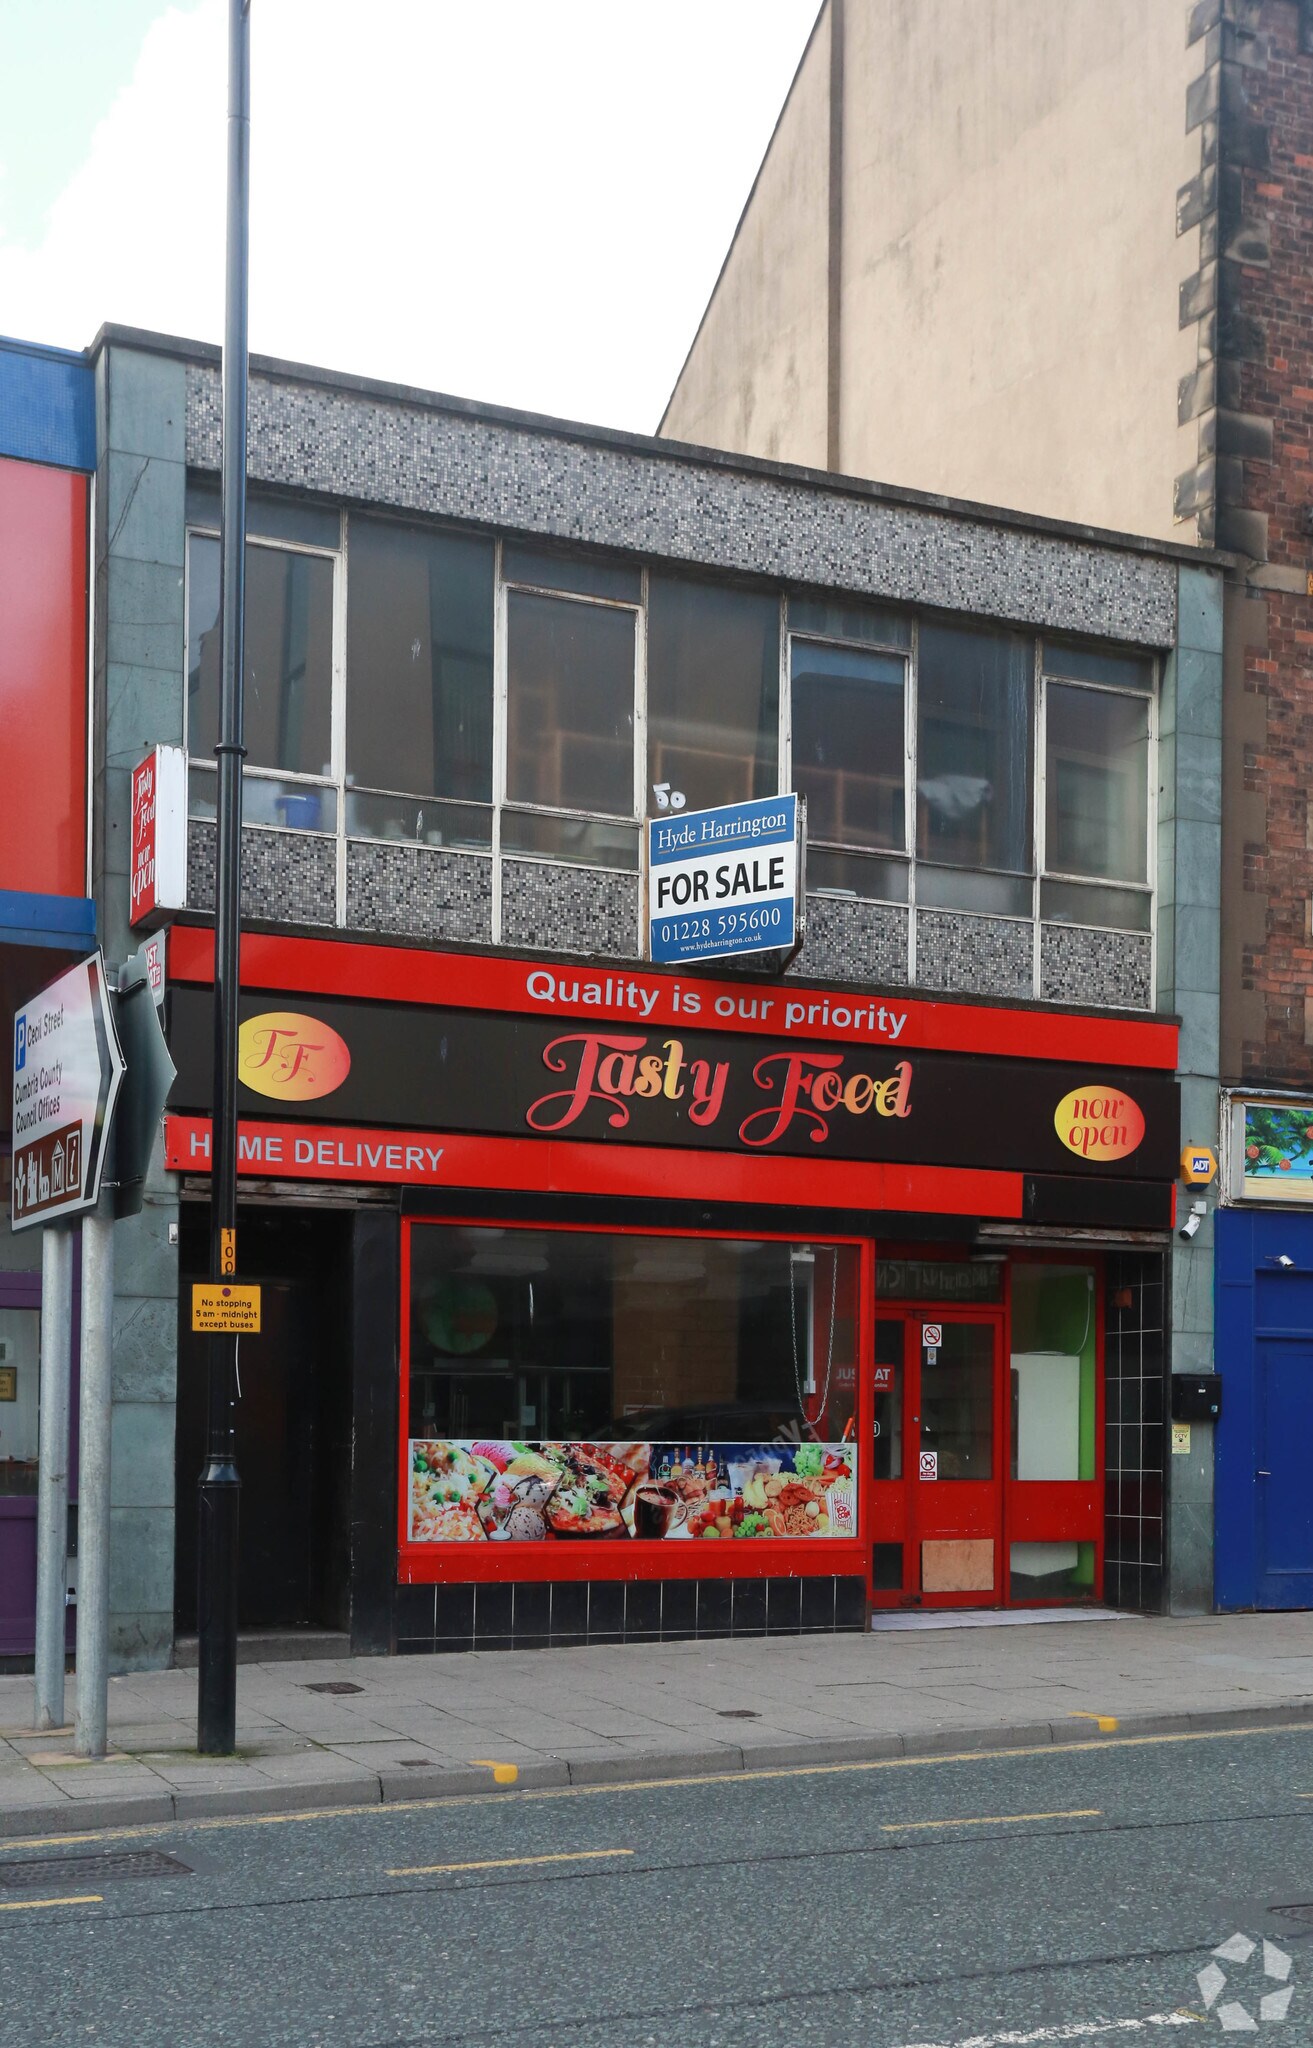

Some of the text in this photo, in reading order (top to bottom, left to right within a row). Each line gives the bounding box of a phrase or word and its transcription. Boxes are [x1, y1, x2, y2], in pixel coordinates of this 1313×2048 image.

[133, 767, 153, 816] Tasty
[136, 795, 155, 847] Food
[658, 812, 787, 852] Hyde Harrington
[133, 858, 155, 906] open
[657, 856, 784, 909] FOR SALE
[661, 907, 782, 943] 01228 595600
[680, 932, 762, 952] www.hydeharrington.co.uk
[526, 970, 908, 1039] Quality is our priority
[27, 1016, 42, 1048] Cecil
[43, 1003, 64, 1038] Street
[15, 1059, 63, 1106] Cumbria County
[526, 1033, 912, 1147] Tasty Food
[15, 1094, 60, 1135] Council Offices
[1073, 1098, 1125, 1120] now
[190, 1132, 445, 1172] HME DELIVERY
[1068, 1125, 1128, 1156] open
[1192, 1160, 1210, 1171] ADT
[201, 1299, 252, 1309] No stopping
[221, 1311, 258, 1320] midnight
[835, 1367, 891, 1381] JUS AT
